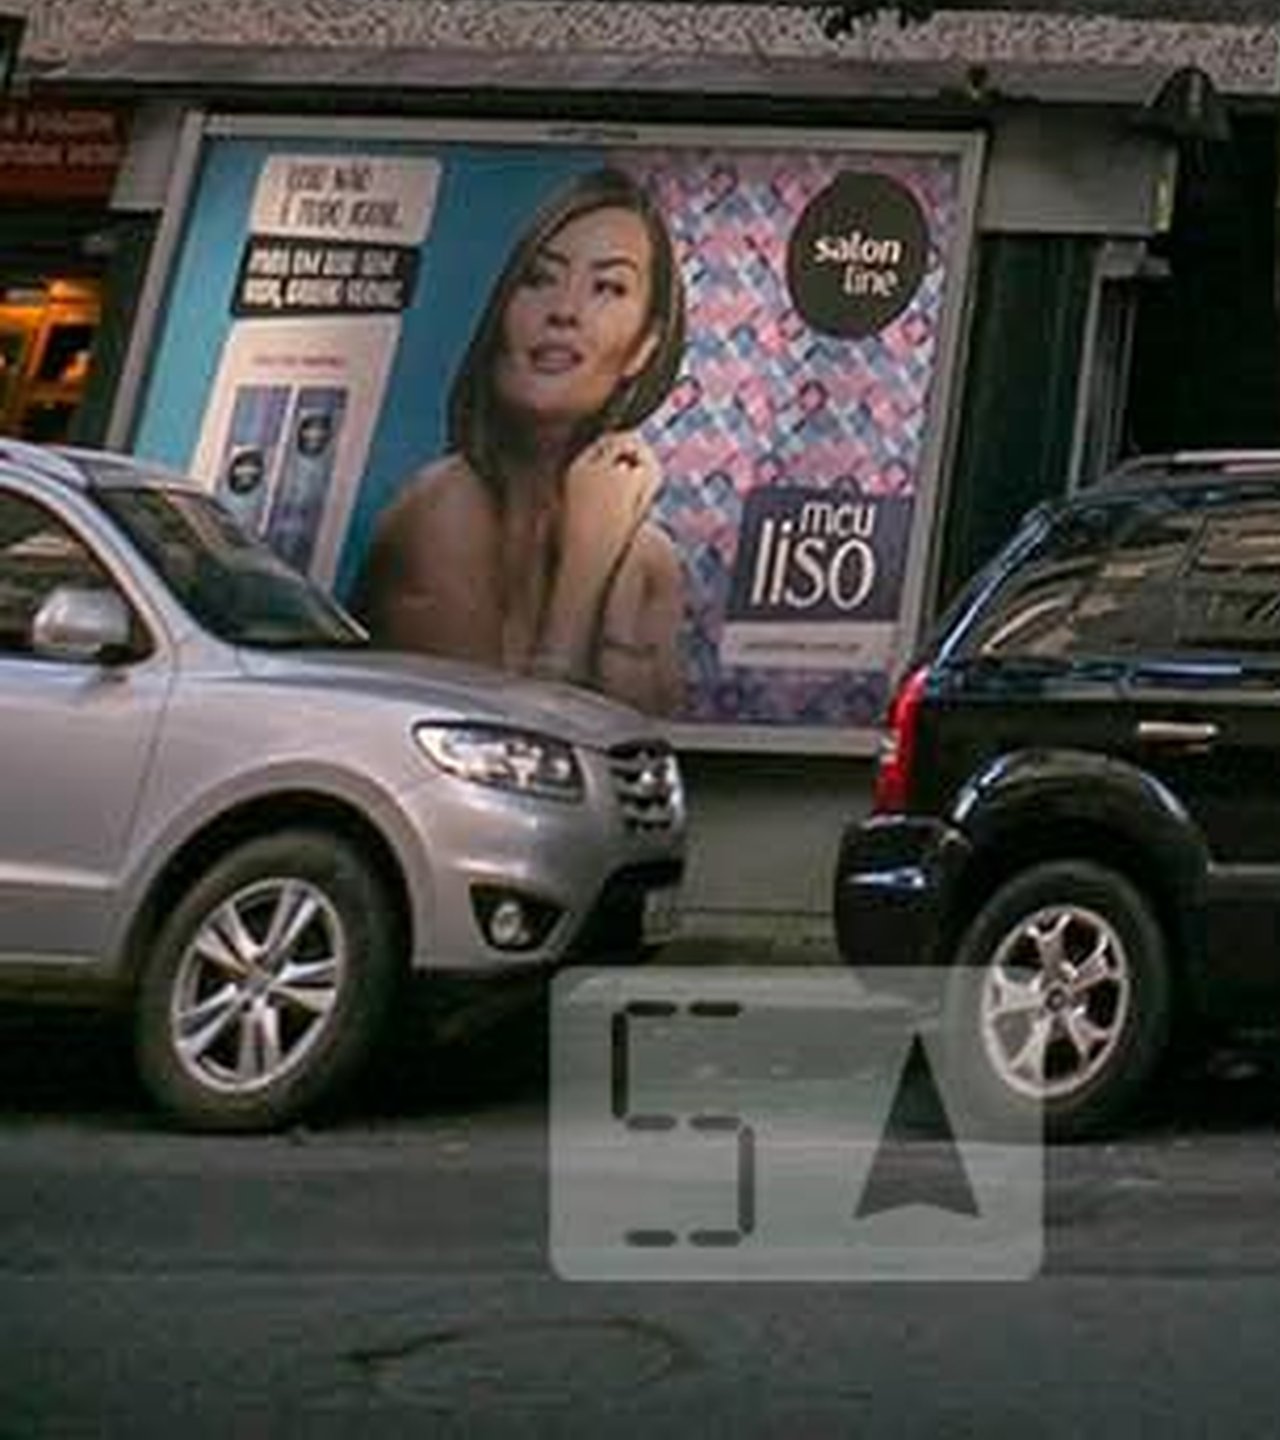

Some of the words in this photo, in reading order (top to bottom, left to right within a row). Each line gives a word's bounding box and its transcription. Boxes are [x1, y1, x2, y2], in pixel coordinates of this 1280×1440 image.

[815, 231, 901, 263] salon
[844, 264, 899, 297] line
[802, 500, 876, 537] meu
[752, 520, 876, 610] liso
